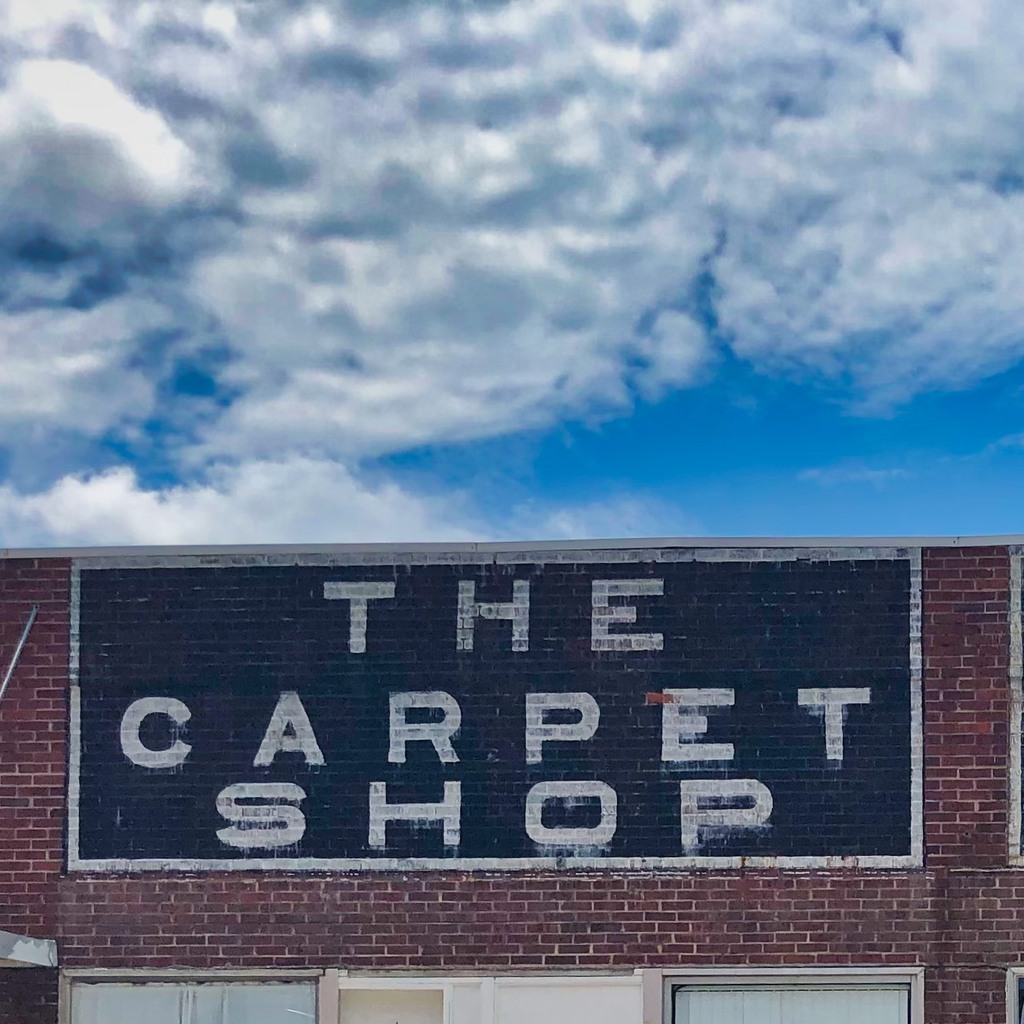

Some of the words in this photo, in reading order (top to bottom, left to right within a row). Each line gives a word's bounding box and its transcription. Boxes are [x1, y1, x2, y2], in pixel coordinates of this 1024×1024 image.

[324, 577, 663, 654] THE
[119, 687, 872, 769] CARPET
[214, 778, 774, 853] SHOP
